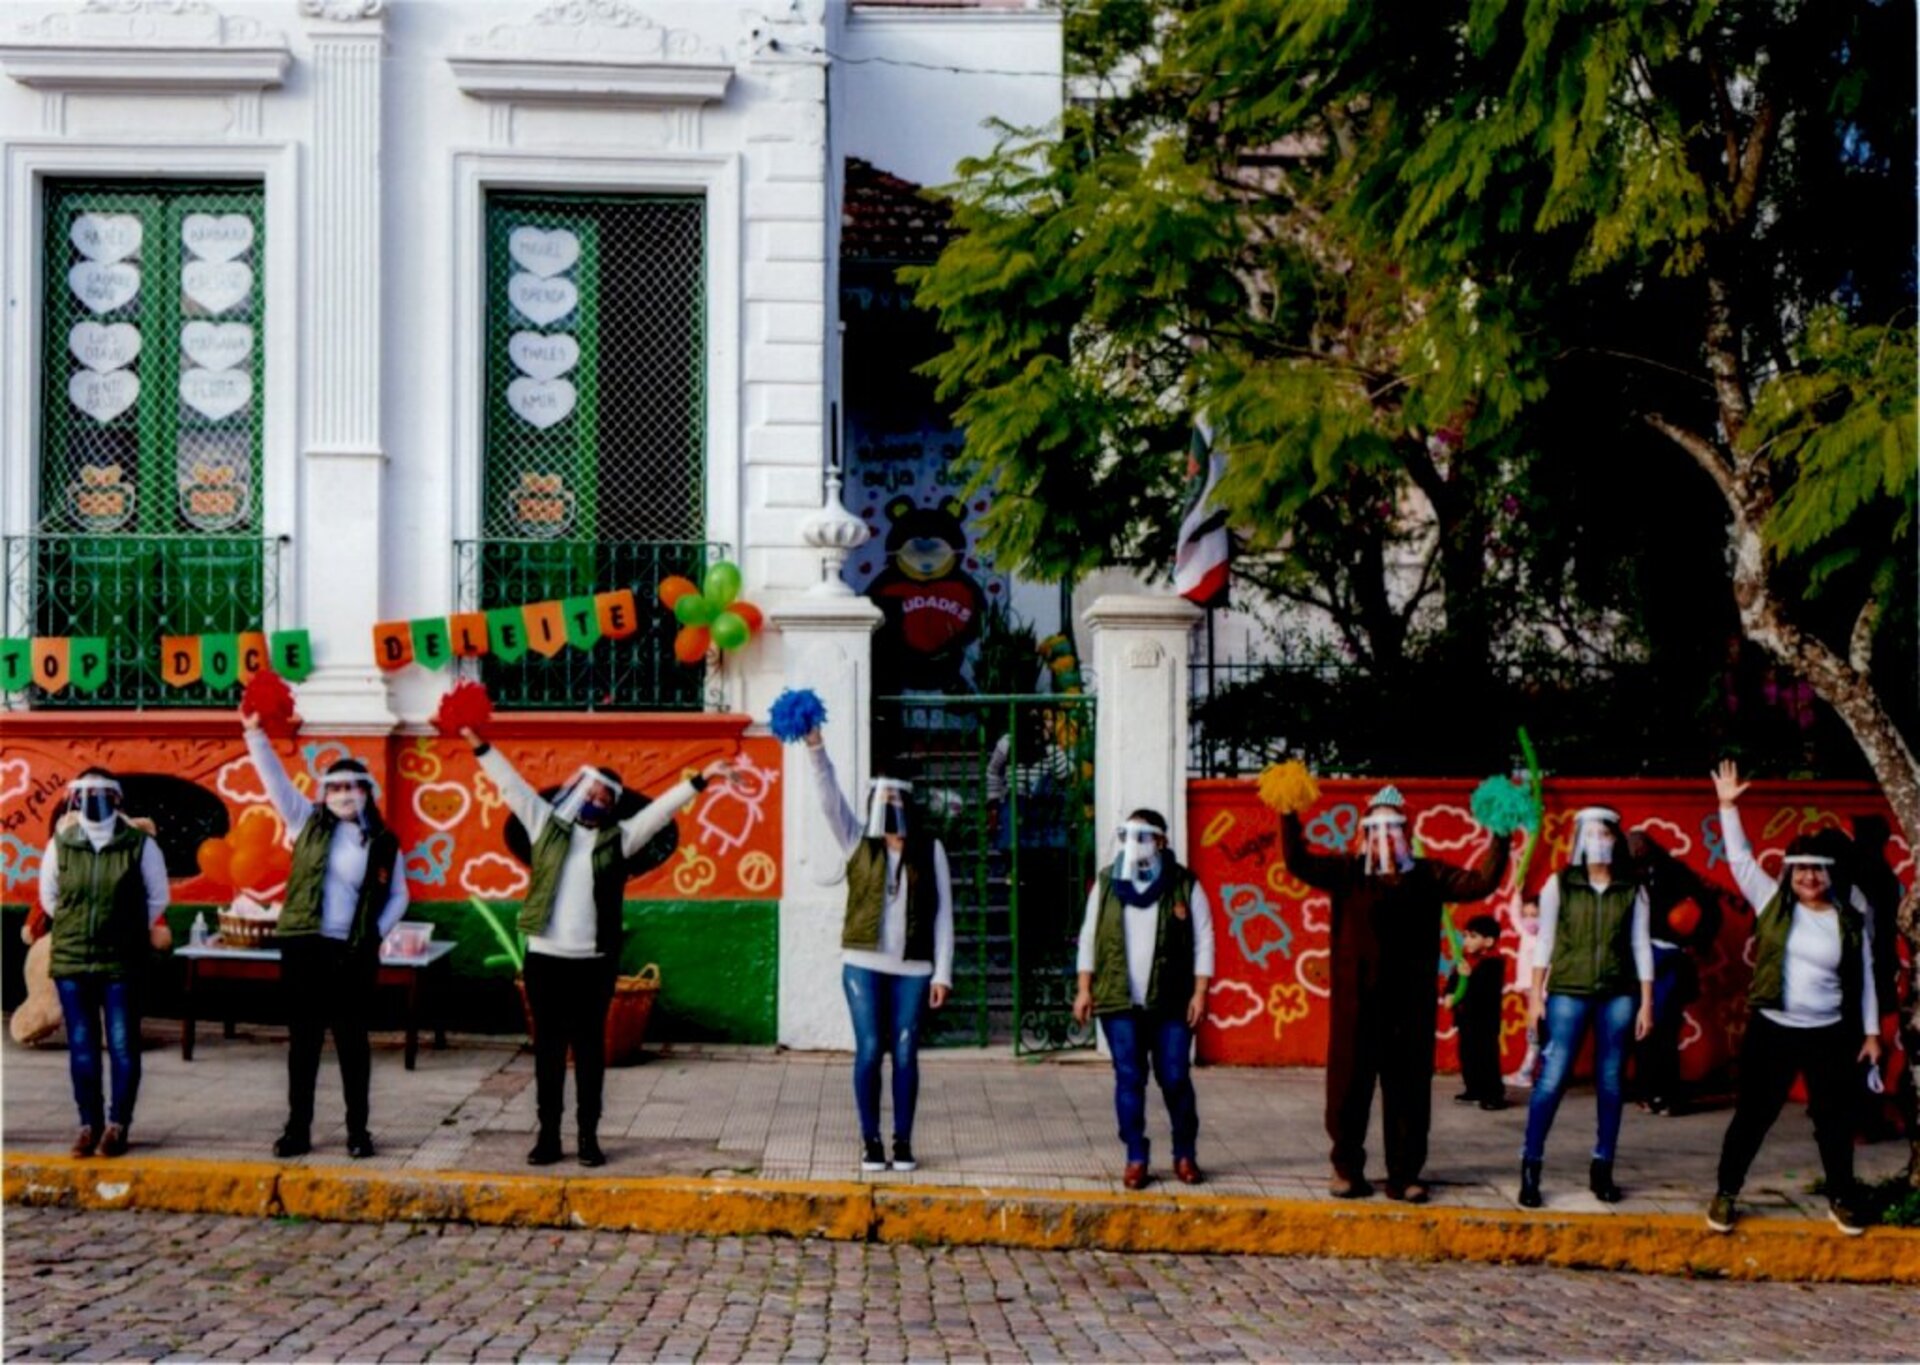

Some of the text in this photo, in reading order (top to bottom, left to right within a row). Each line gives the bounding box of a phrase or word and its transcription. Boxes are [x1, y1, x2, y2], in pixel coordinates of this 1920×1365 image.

[3, 605, 625, 680] TOP DOCE DELEITE
[26, 773, 66, 822] feliz
